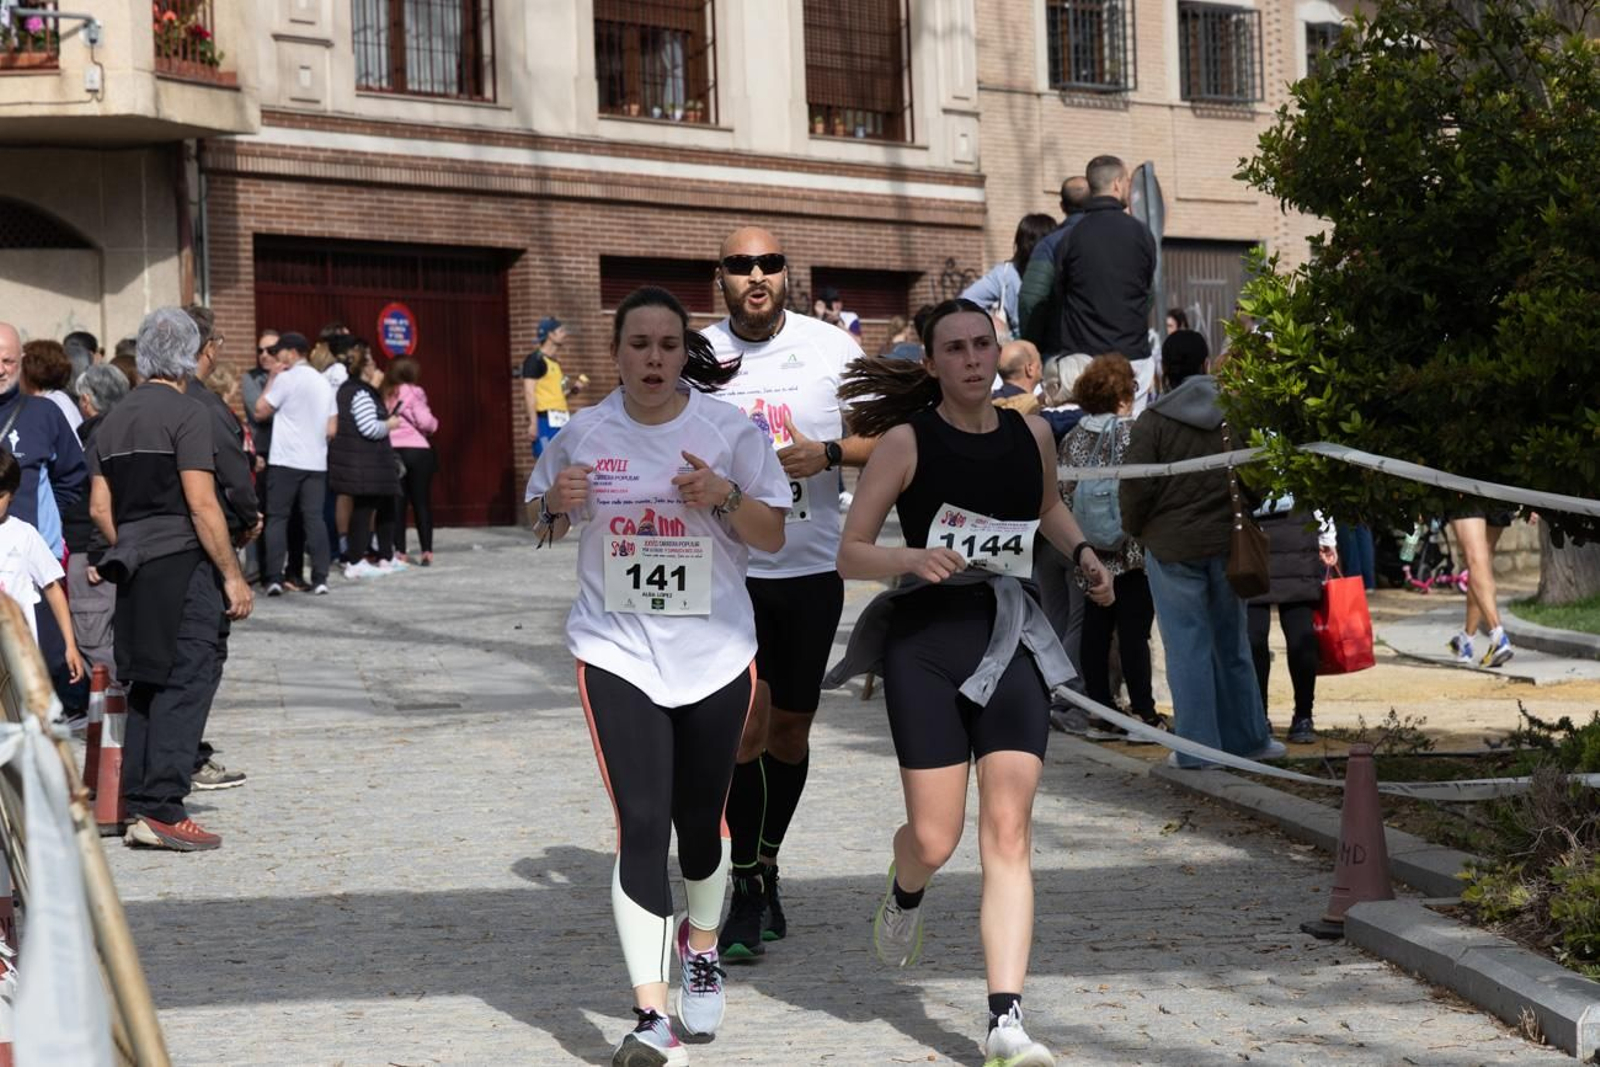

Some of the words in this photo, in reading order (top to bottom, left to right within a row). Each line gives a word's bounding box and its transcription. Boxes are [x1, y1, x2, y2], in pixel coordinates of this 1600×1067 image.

[595, 458, 628, 472] XXVII
[940, 533, 1024, 558] 1144
[625, 563, 686, 591] 141
